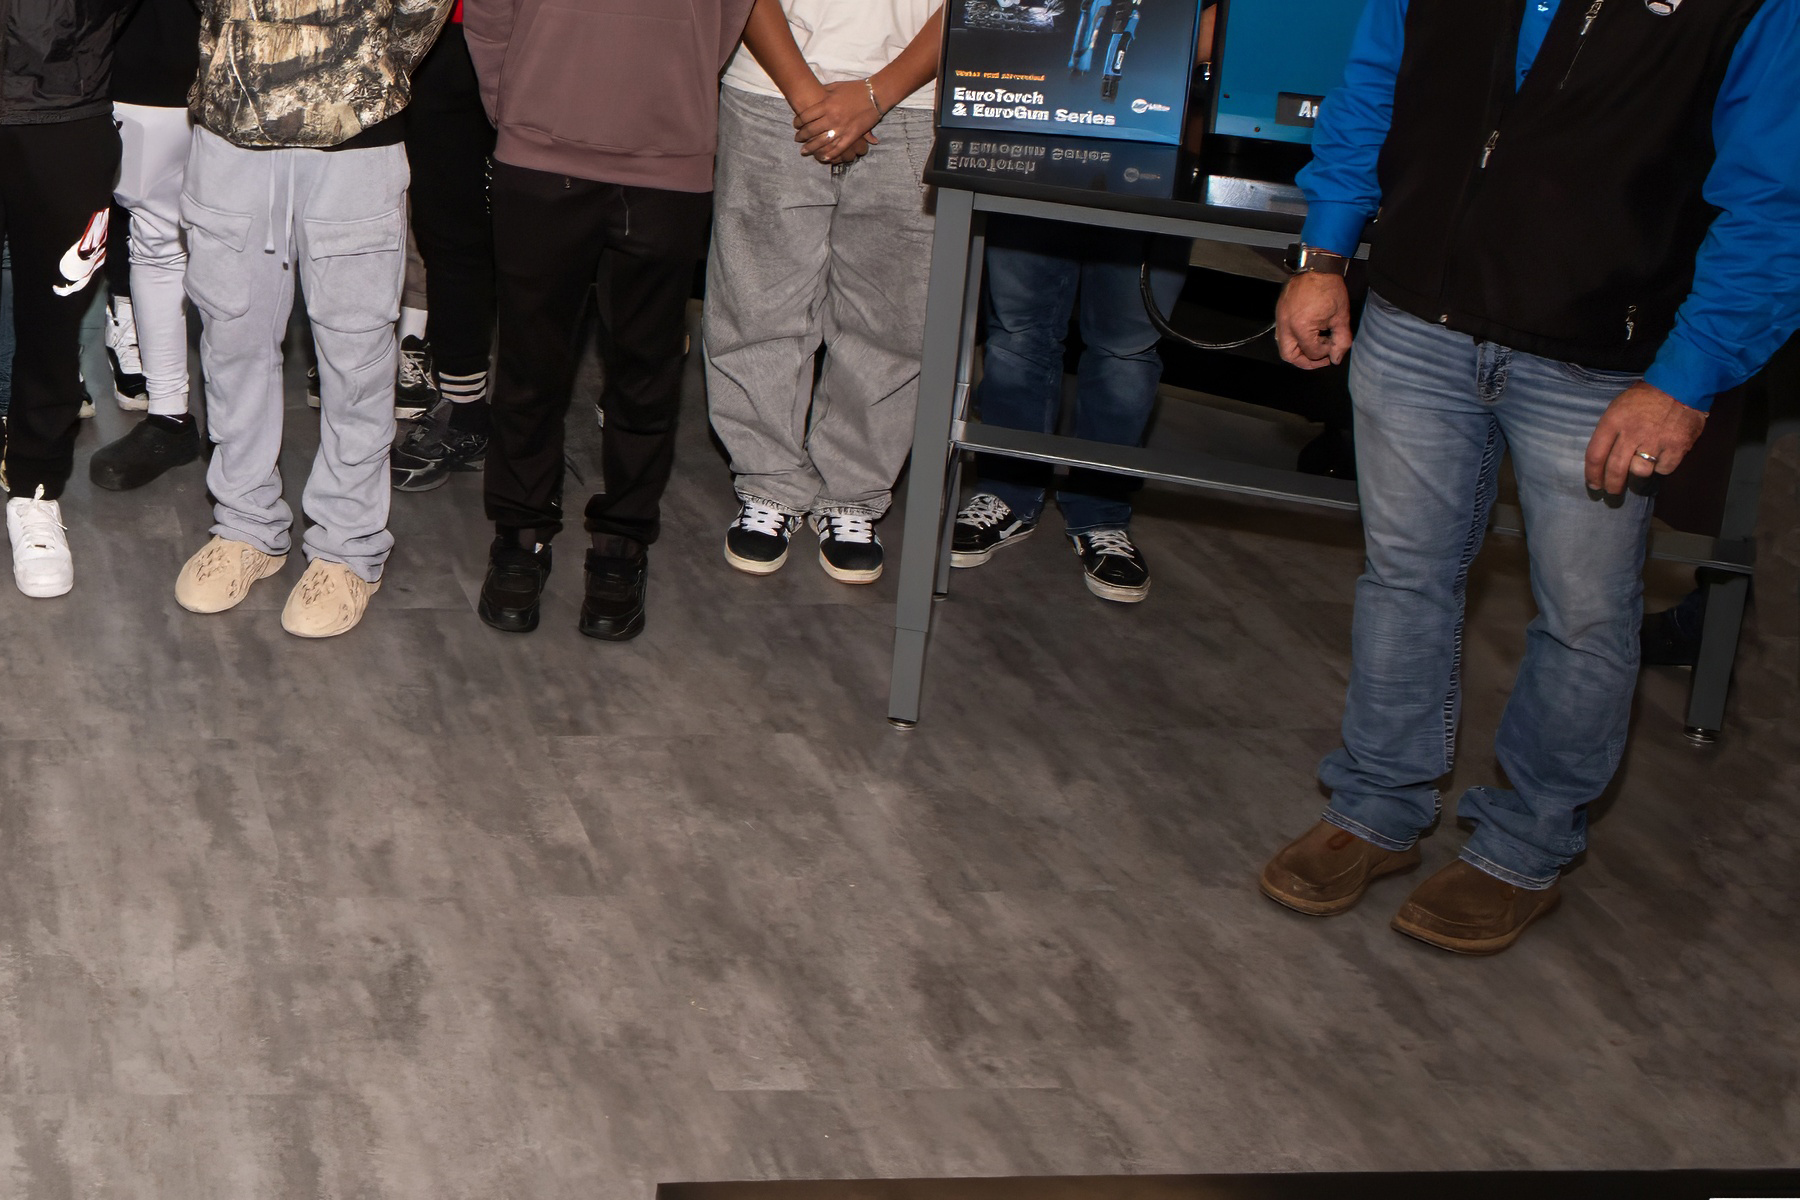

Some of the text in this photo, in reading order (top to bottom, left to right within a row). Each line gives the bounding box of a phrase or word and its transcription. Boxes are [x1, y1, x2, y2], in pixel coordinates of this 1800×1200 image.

[953, 86, 1044, 105] EuroTorch
[951, 102, 1117, 126] & EuroGun Series
